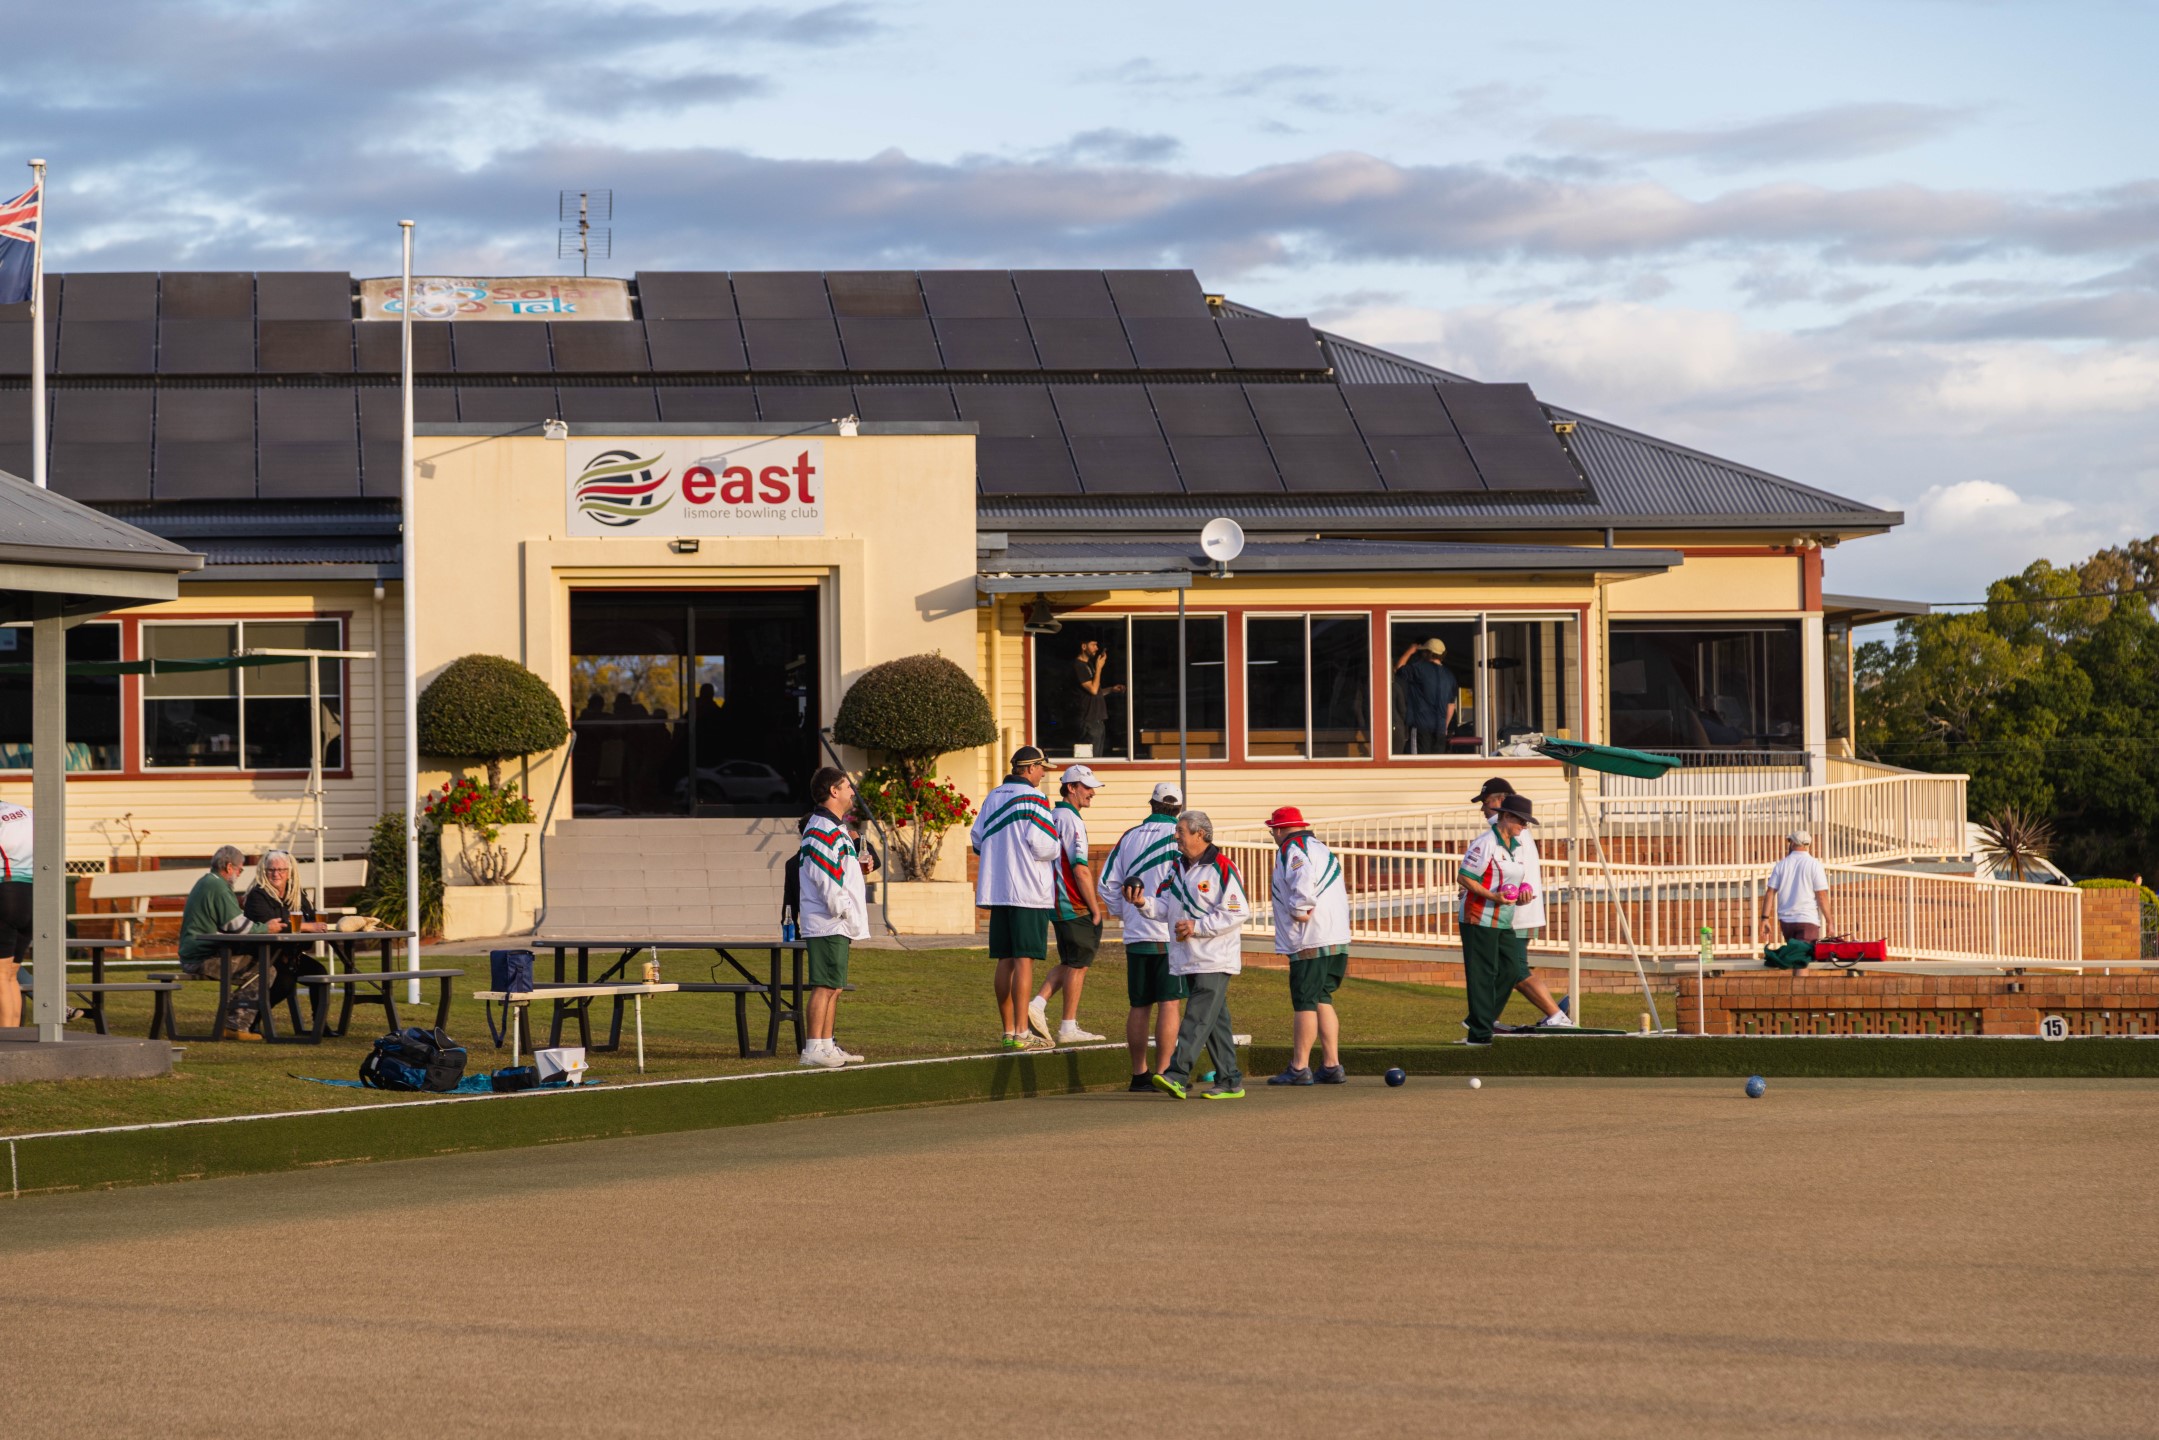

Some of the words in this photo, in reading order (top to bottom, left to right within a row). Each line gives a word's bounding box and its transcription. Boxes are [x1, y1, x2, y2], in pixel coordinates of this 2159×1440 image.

[493, 297, 576, 314] Tek
[681, 449, 816, 504] east
[684, 507, 731, 518] lismore
[735, 507, 787, 520] bowling
[791, 507, 819, 518] club
[1, 809, 27, 821] east
[2044, 1019, 2063, 1037] 15
